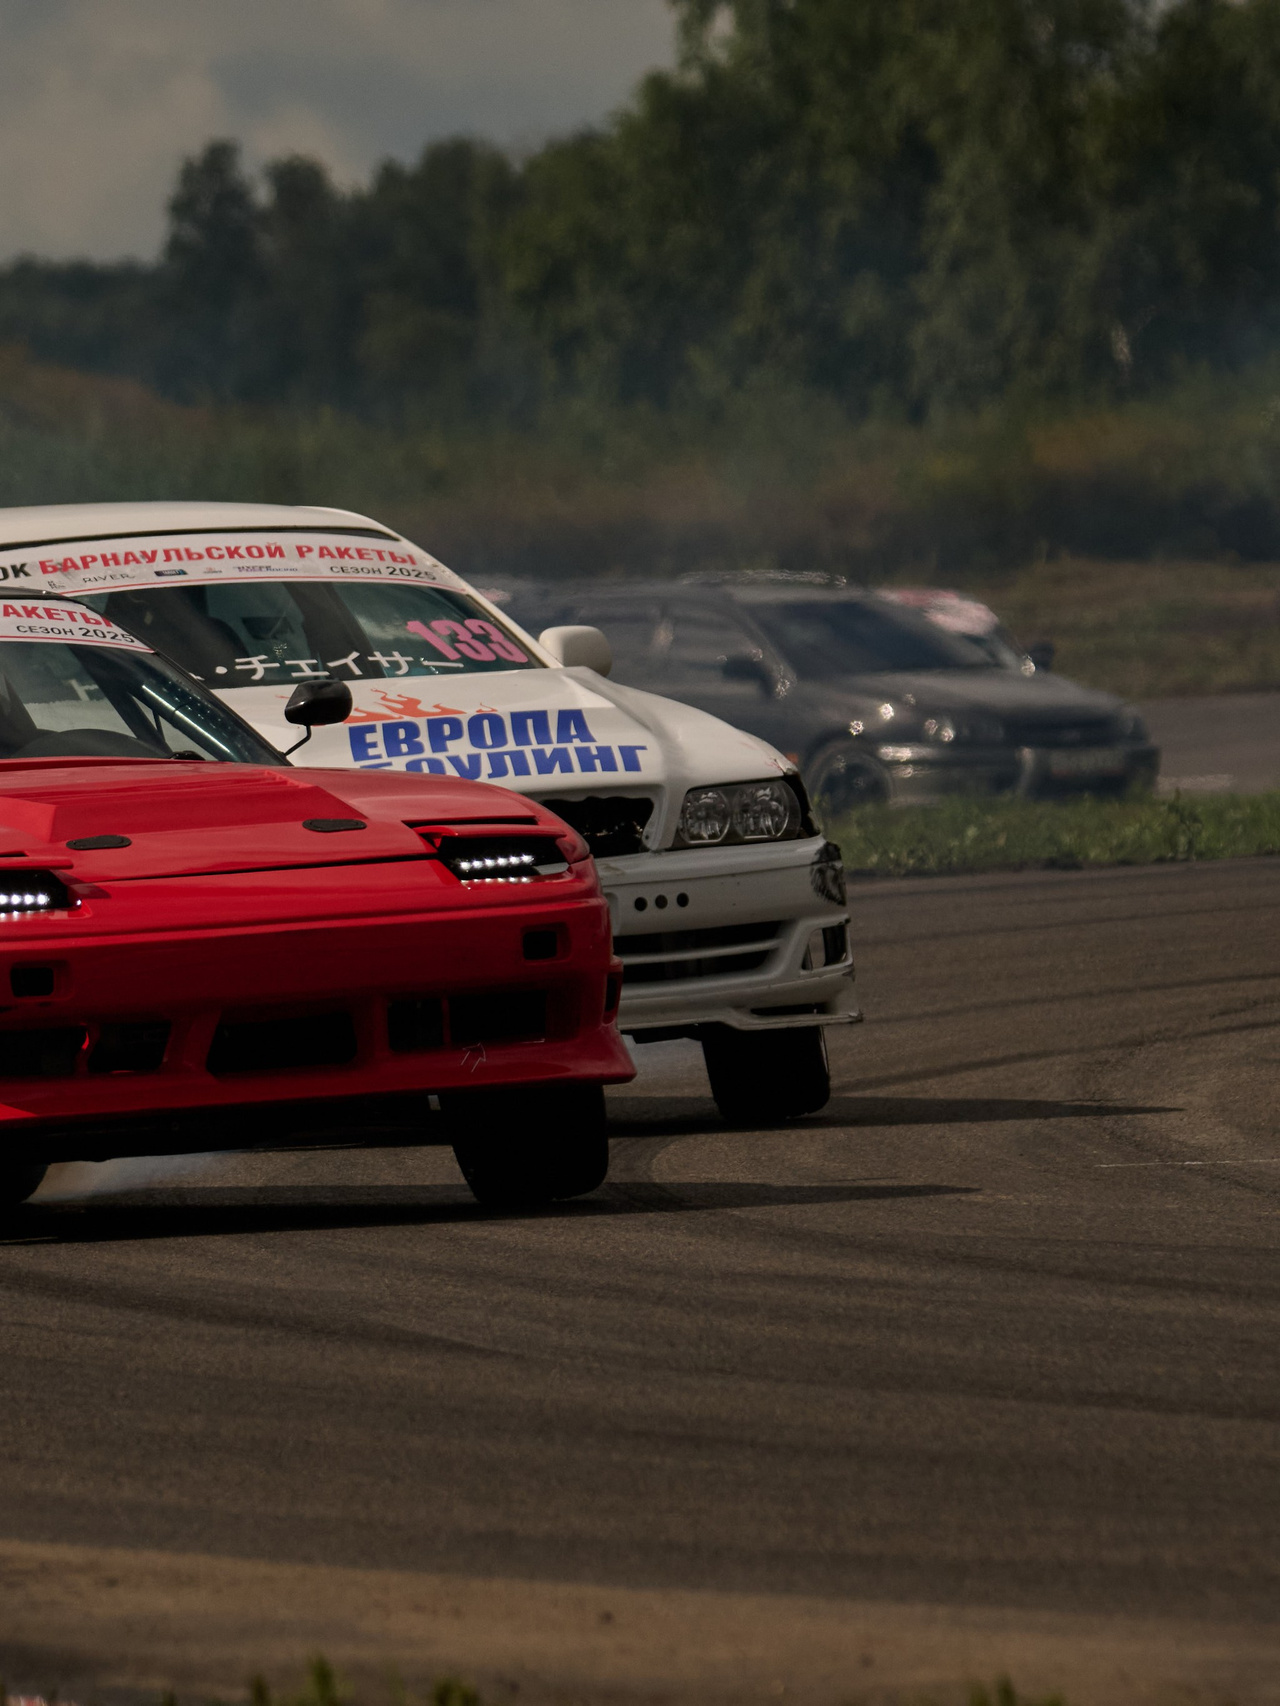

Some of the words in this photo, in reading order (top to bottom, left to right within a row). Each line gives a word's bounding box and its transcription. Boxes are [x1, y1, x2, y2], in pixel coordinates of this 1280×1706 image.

[38, 542, 286, 575] БАРНАУЛЬСКОЙ
[296, 545, 418, 566] РАКЕТЫ
[329, 565, 382, 575] СЕЗОН
[386, 566, 437, 580] 2025
[82, 573, 136, 584] RIVER
[16, 624, 75, 636] СЕЗОН
[78, 627, 135, 643] 2025
[406, 618, 529, 664] 133
[348, 709, 597, 762] ЕВРОПА
[360, 745, 648, 781] ОУЛИНГ
